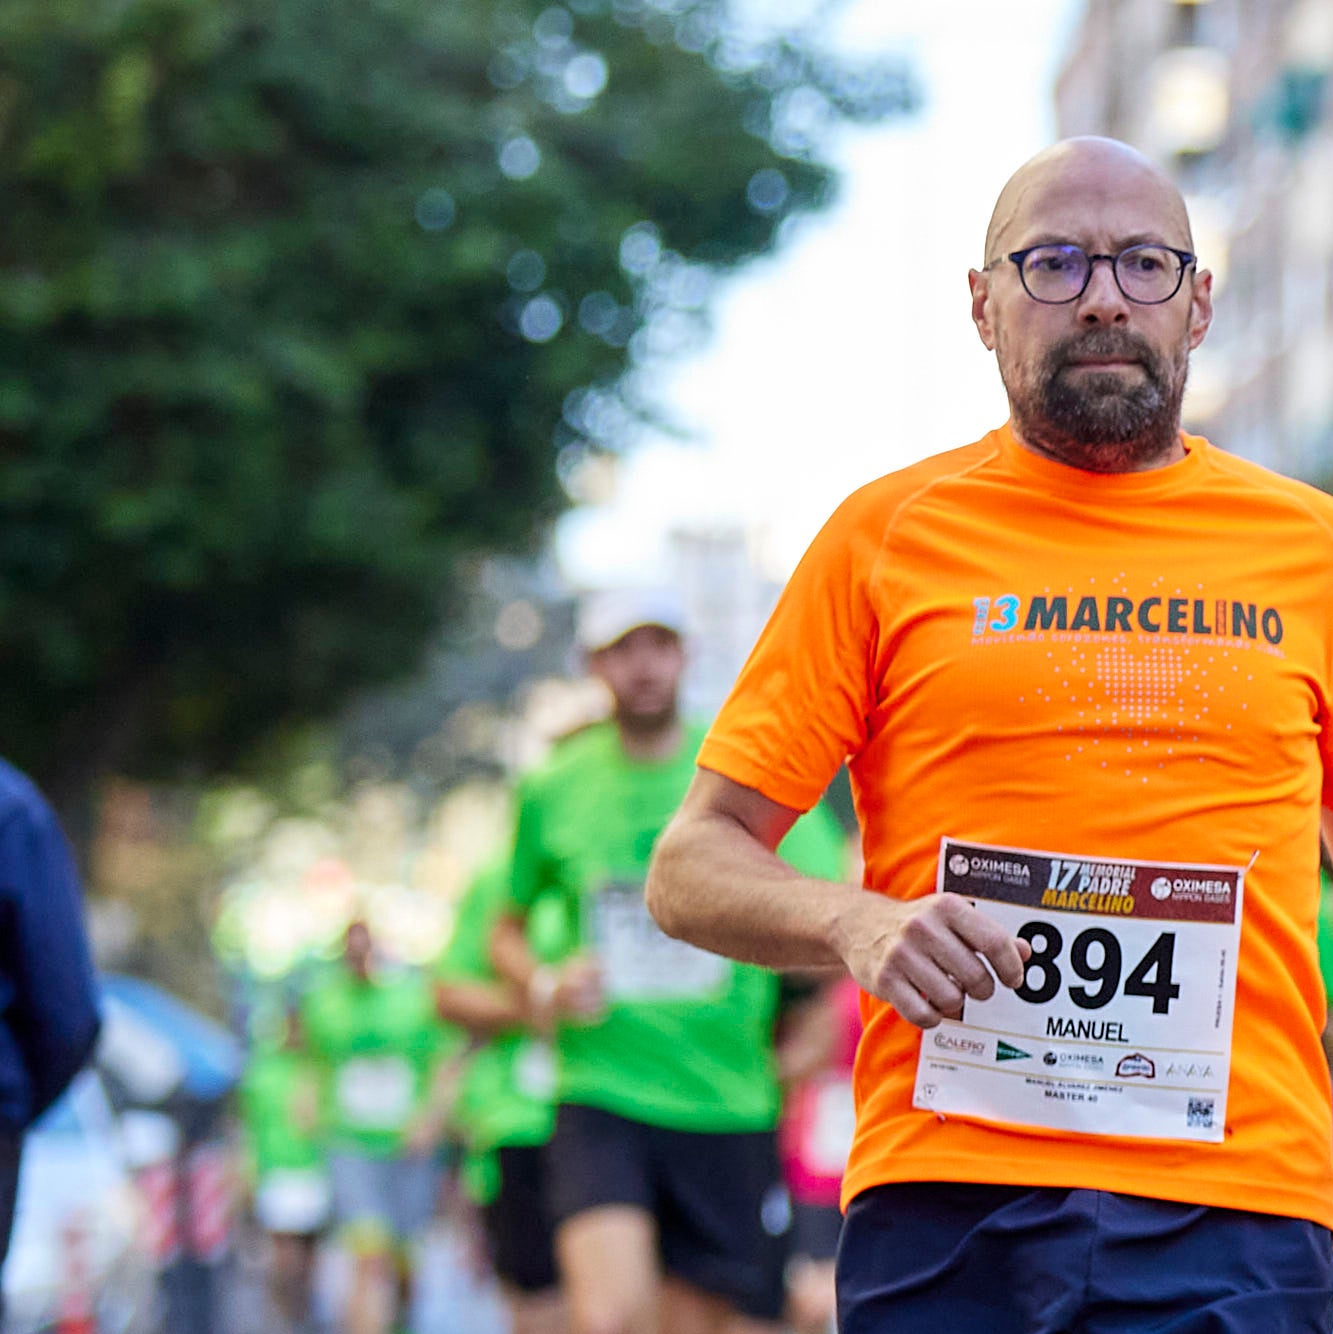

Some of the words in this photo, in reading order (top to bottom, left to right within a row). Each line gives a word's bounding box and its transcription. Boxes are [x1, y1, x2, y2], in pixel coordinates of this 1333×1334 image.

[1023, 596, 1285, 645] MARCELINO
[970, 856, 1031, 877] OXIMESA
[1047, 859, 1081, 892] 17
[1079, 862, 1136, 880] MEMORIAL
[1078, 875, 1132, 897] PADRE
[1172, 879, 1232, 894] OXIMESA
[1040, 888, 1136, 914] MARCELINO
[1013, 921, 1180, 1015] 894
[1046, 1016, 1130, 1043] MANUEL
[1044, 1089, 1085, 1101] MASTER
